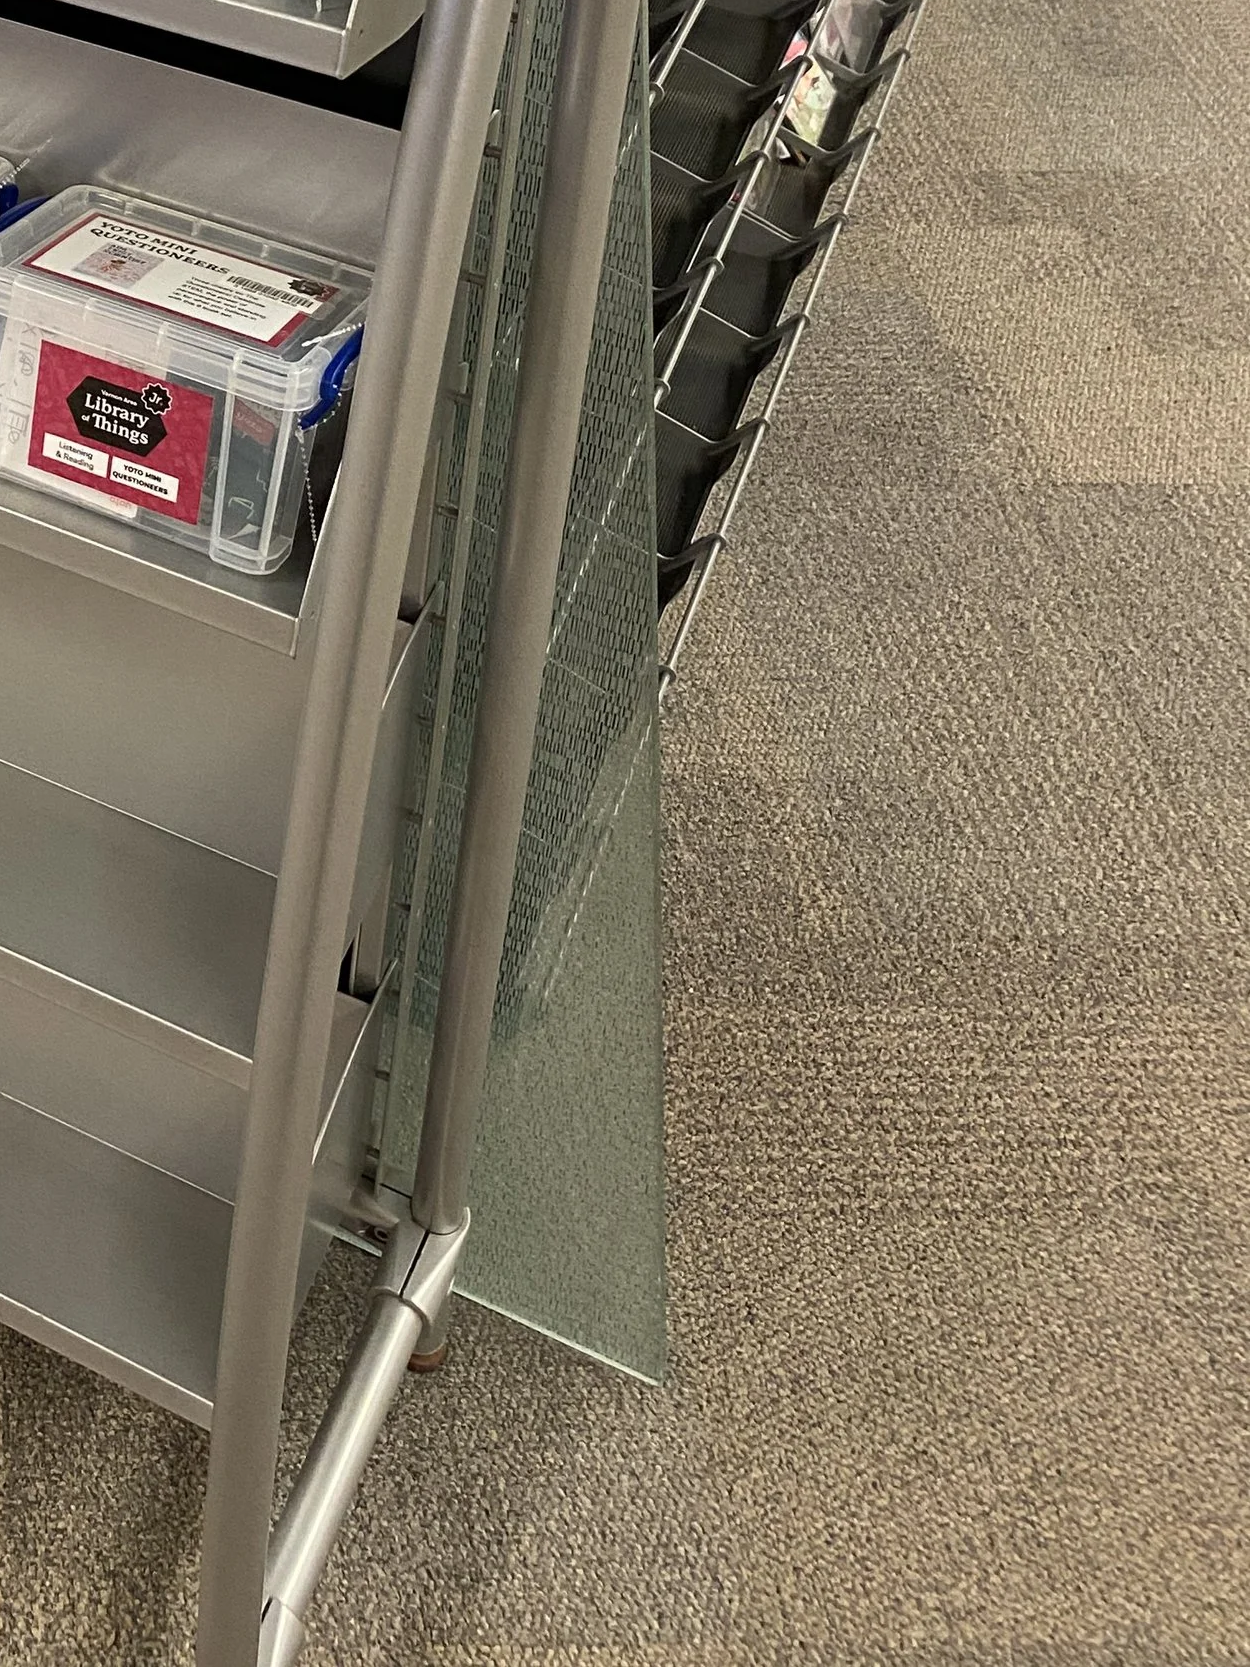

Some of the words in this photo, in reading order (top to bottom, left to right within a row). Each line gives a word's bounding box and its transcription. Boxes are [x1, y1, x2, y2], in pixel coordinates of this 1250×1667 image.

[90, 227, 230, 275] QUESTIONEERS
[100, 221, 150, 240] YOTO
[150, 237, 199, 255] MINI
[84, 393, 149, 429] Library
[91, 413, 149, 445] Things
[55, 450, 62, 458] &
[63, 452, 95, 471] Reading
[58, 440, 93, 461] Listening
[112, 470, 168, 495] QUESTIONEERS
[123, 464, 144, 476] YOTO
[145, 471, 162, 483] MINI
